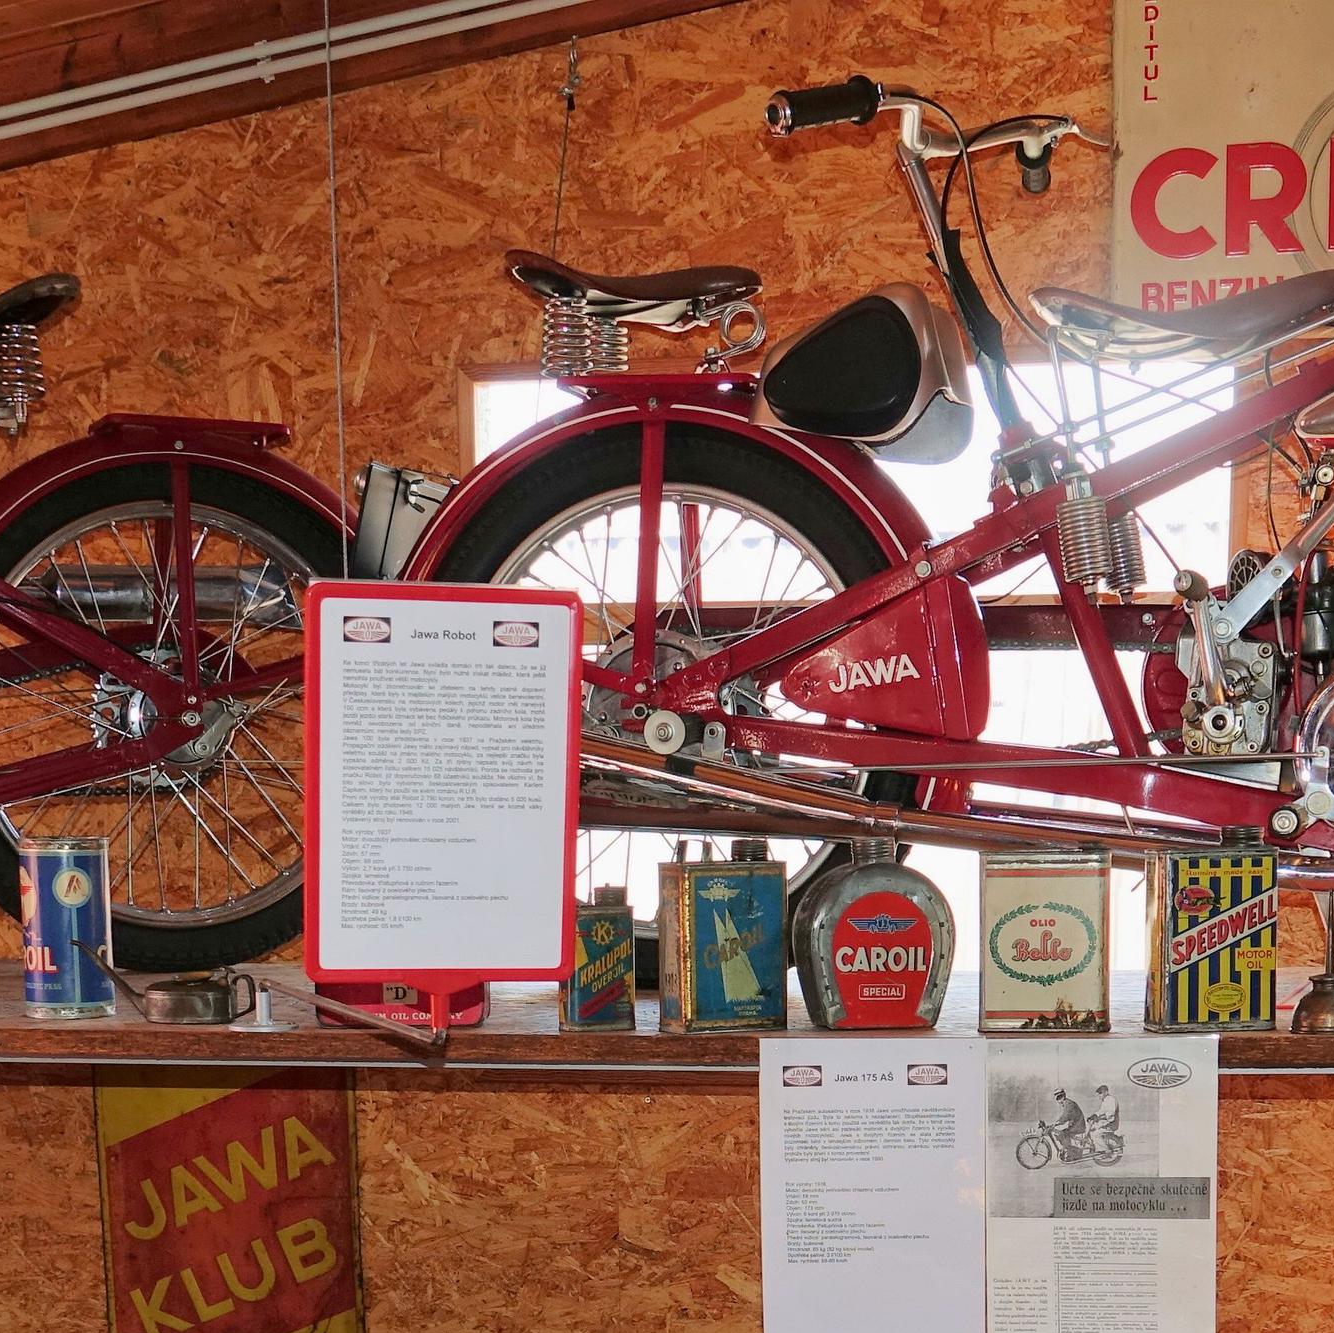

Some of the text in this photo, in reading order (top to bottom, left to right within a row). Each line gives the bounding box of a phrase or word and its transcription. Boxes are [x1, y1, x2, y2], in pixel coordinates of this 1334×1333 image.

[1143, 0, 1159, 101] DITUL
[411, 629, 476, 641] Jawa Robot
[828, 653, 921, 694] JAWA
[1029, 919, 1057, 927] OLIO
[1171, 894, 1277, 966] SPEEDWELL
[835, 946, 927, 973] CAROIL
[1237, 950, 1273, 959] MOTOR
[1247, 960, 1263, 969] OIL
[862, 986, 902, 998] SPECIAL
[1141, 1063, 1179, 1073] JAWA
[834, 1072, 858, 1082] Jawa
[861, 1072, 878, 1082] 175
[123, 1115, 336, 1241] JAWA
[1092, 1202, 1105, 1211] na
[1110, 1199, 1165, 1213] motocyklu
